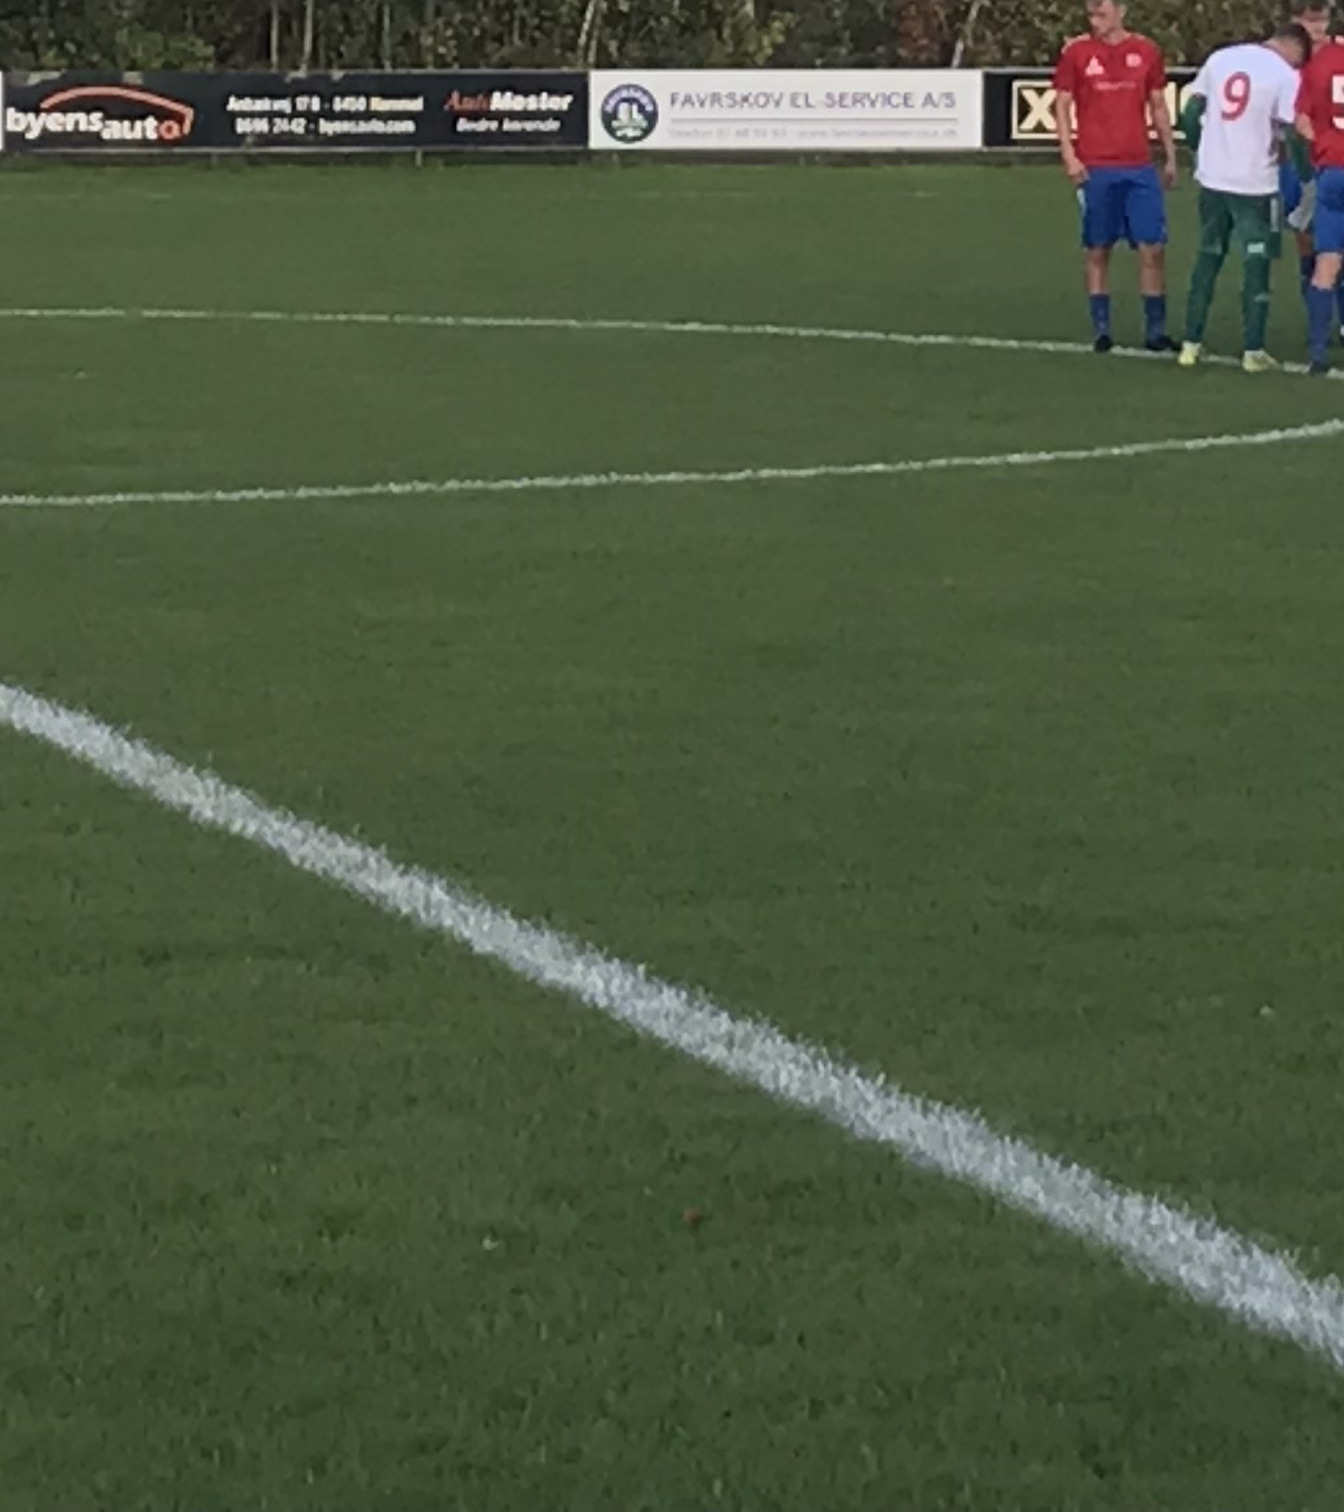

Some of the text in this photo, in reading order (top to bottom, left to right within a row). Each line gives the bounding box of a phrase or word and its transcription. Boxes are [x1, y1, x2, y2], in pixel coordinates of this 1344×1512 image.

[670, 92, 784, 109] FAVRSKOV
[921, 92, 957, 109] A/S
[1221, 71, 1253, 121] 9
